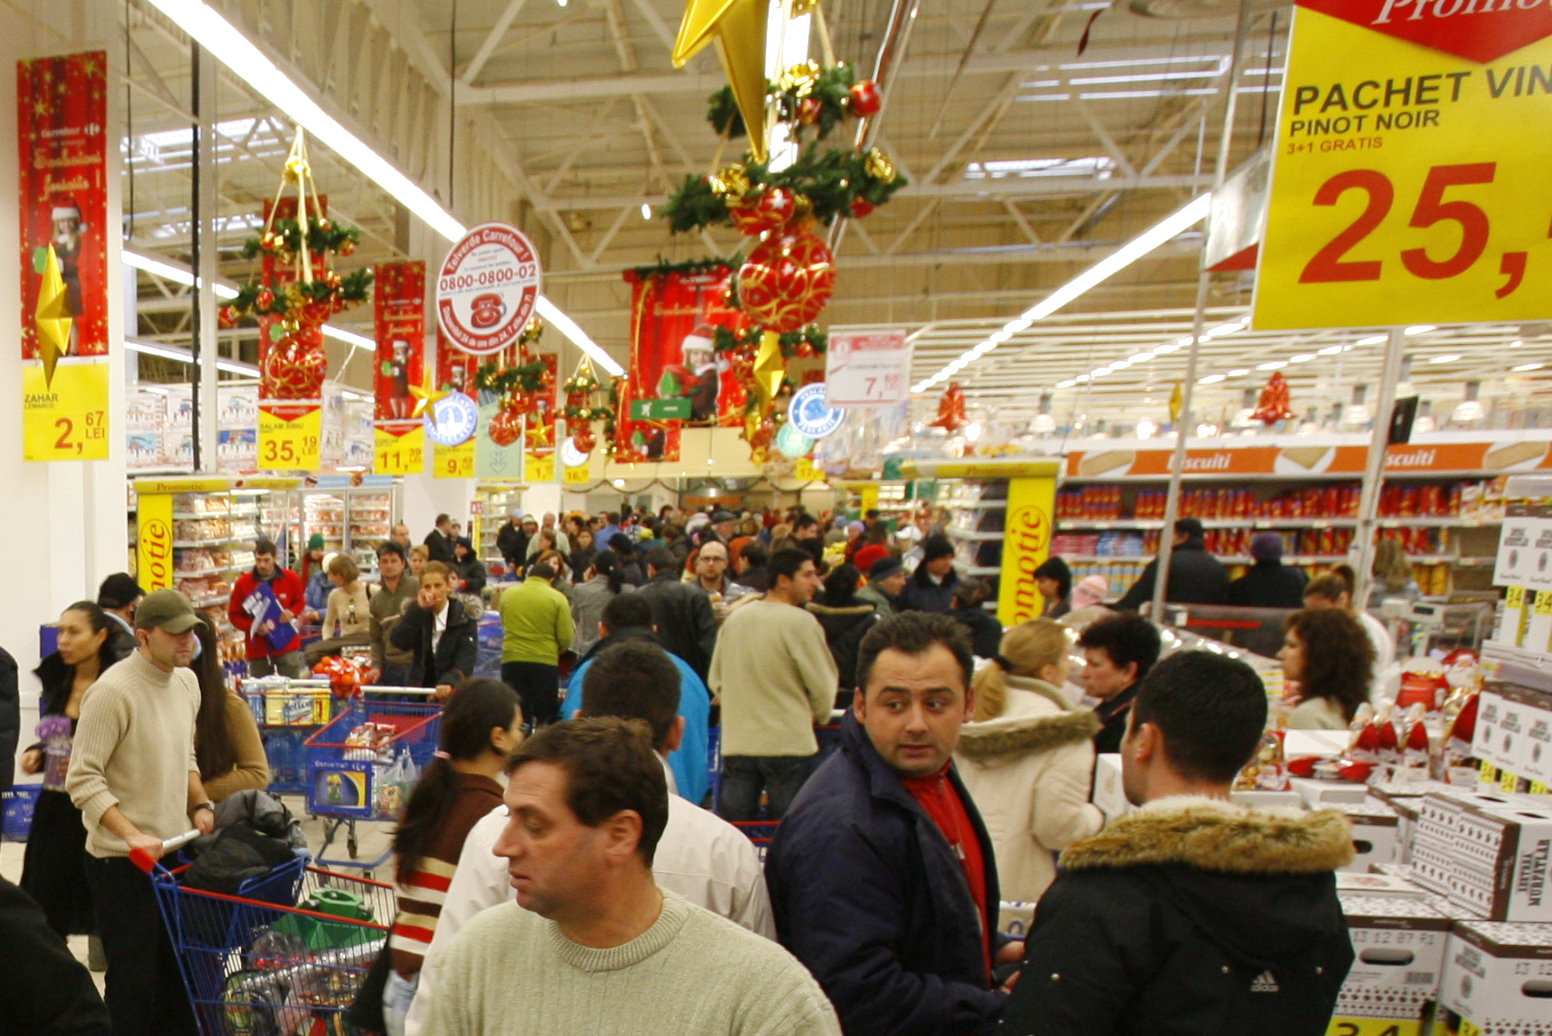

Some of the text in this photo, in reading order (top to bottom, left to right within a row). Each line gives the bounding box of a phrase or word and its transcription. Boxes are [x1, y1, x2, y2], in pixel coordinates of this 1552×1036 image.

[1372, 0, 1552, 24] Promo
[1292, 71, 1471, 116] PACHET
[1289, 109, 1440, 138] PINOT NOIR
[1287, 137, 1384, 155] 3+1 GRATIS
[1298, 162, 1528, 300] 25,
[447, 234, 481, 270] Telverde
[439, 264, 537, 292] 0800-0800-02
[24, 393, 58, 403] ZAHAR
[54, 410, 104, 455] 2, 67
[85, 427, 105, 439] LEI
[264, 439, 301, 466] 35,
